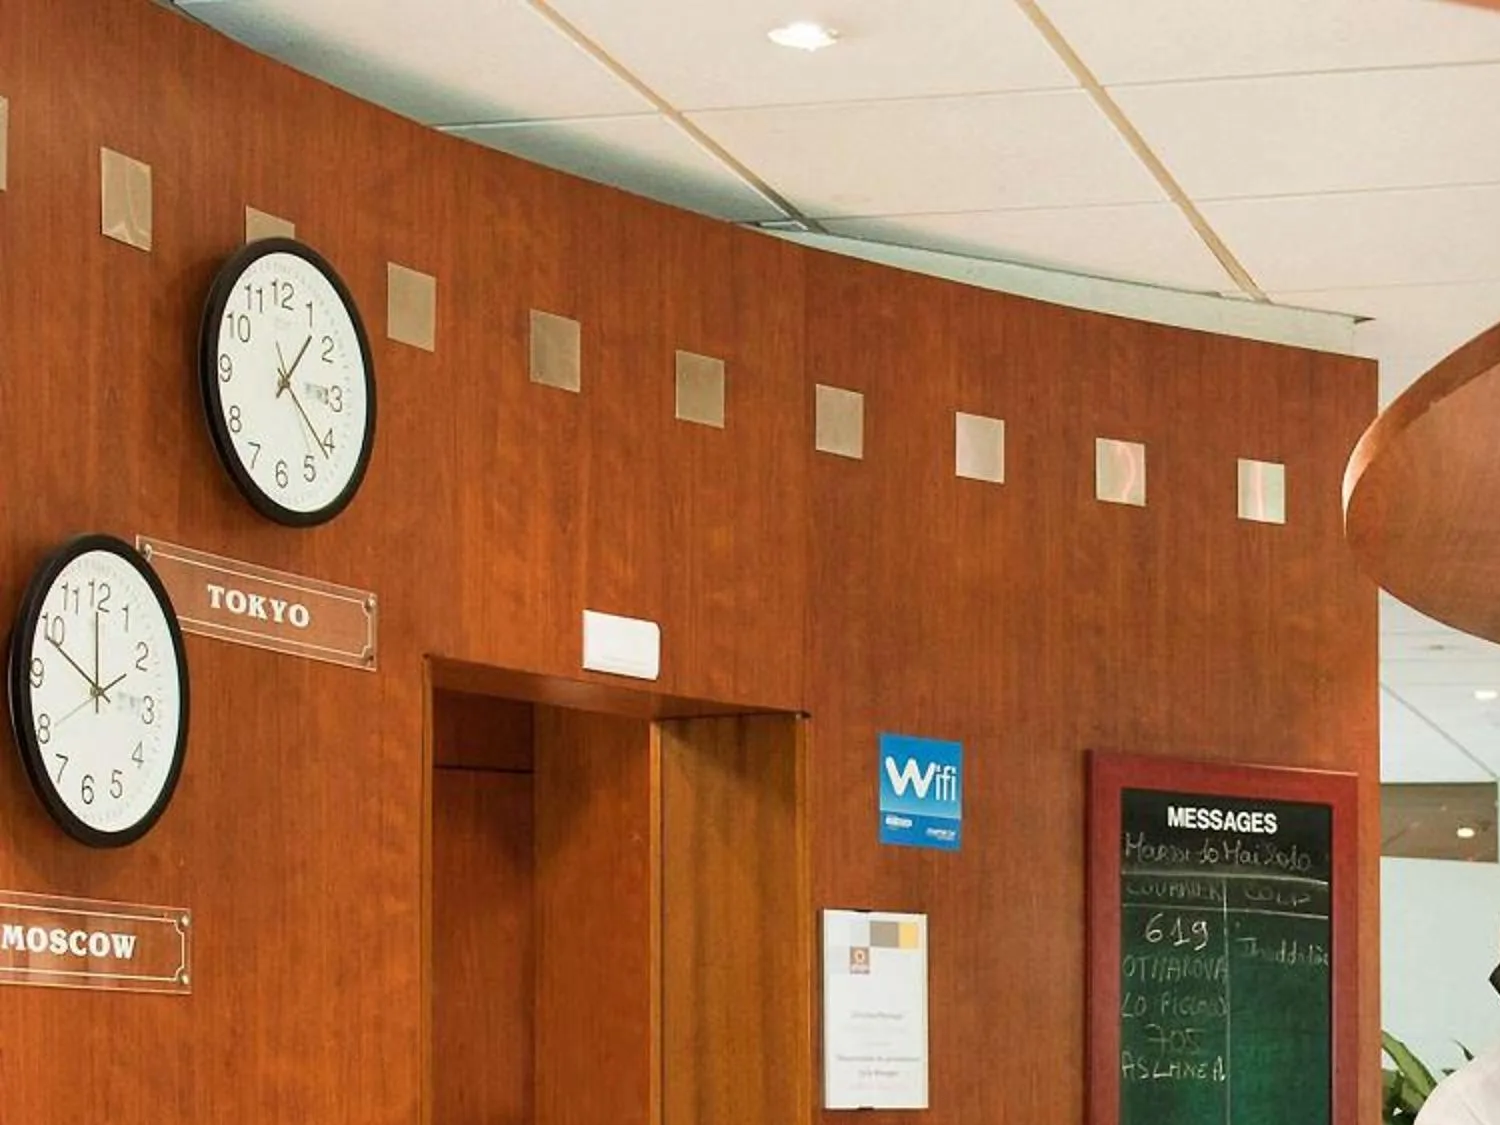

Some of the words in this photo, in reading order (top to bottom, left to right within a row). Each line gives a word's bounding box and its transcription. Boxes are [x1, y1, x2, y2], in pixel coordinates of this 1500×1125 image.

[245, 283, 263, 314] 11
[272, 279, 294, 311] 12
[227, 312, 251, 342] 10
[306, 301, 313, 327] 1
[322, 336, 334, 363] 2
[220, 354, 232, 382] 9
[329, 386, 342, 412] 3
[229, 406, 241, 433] 8
[248, 442, 261, 468] 7
[324, 428, 335, 453] 4
[276, 460, 288, 488] 6
[304, 455, 316, 482] 5
[61, 582, 78, 615] 11
[88, 580, 111, 613] 12
[207, 584, 310, 629] TOKYO
[42, 613, 65, 647] 10
[122, 604, 129, 632] 1
[136, 641, 149, 672] 2
[30, 658, 44, 688] 9
[142, 696, 155, 724] 3
[37, 713, 51, 744] 8
[56, 753, 69, 784] 7
[132, 740, 144, 769] 4
[81, 774, 94, 805] 6
[110, 769, 123, 799] 5
[885, 755, 957, 801] Wifi
[1167, 806, 1278, 835] MESSAGES
[2, 924, 137, 961] MOSCOW
[1144, 913, 1209, 951] 619
[1144, 1023, 1207, 1057] 705
